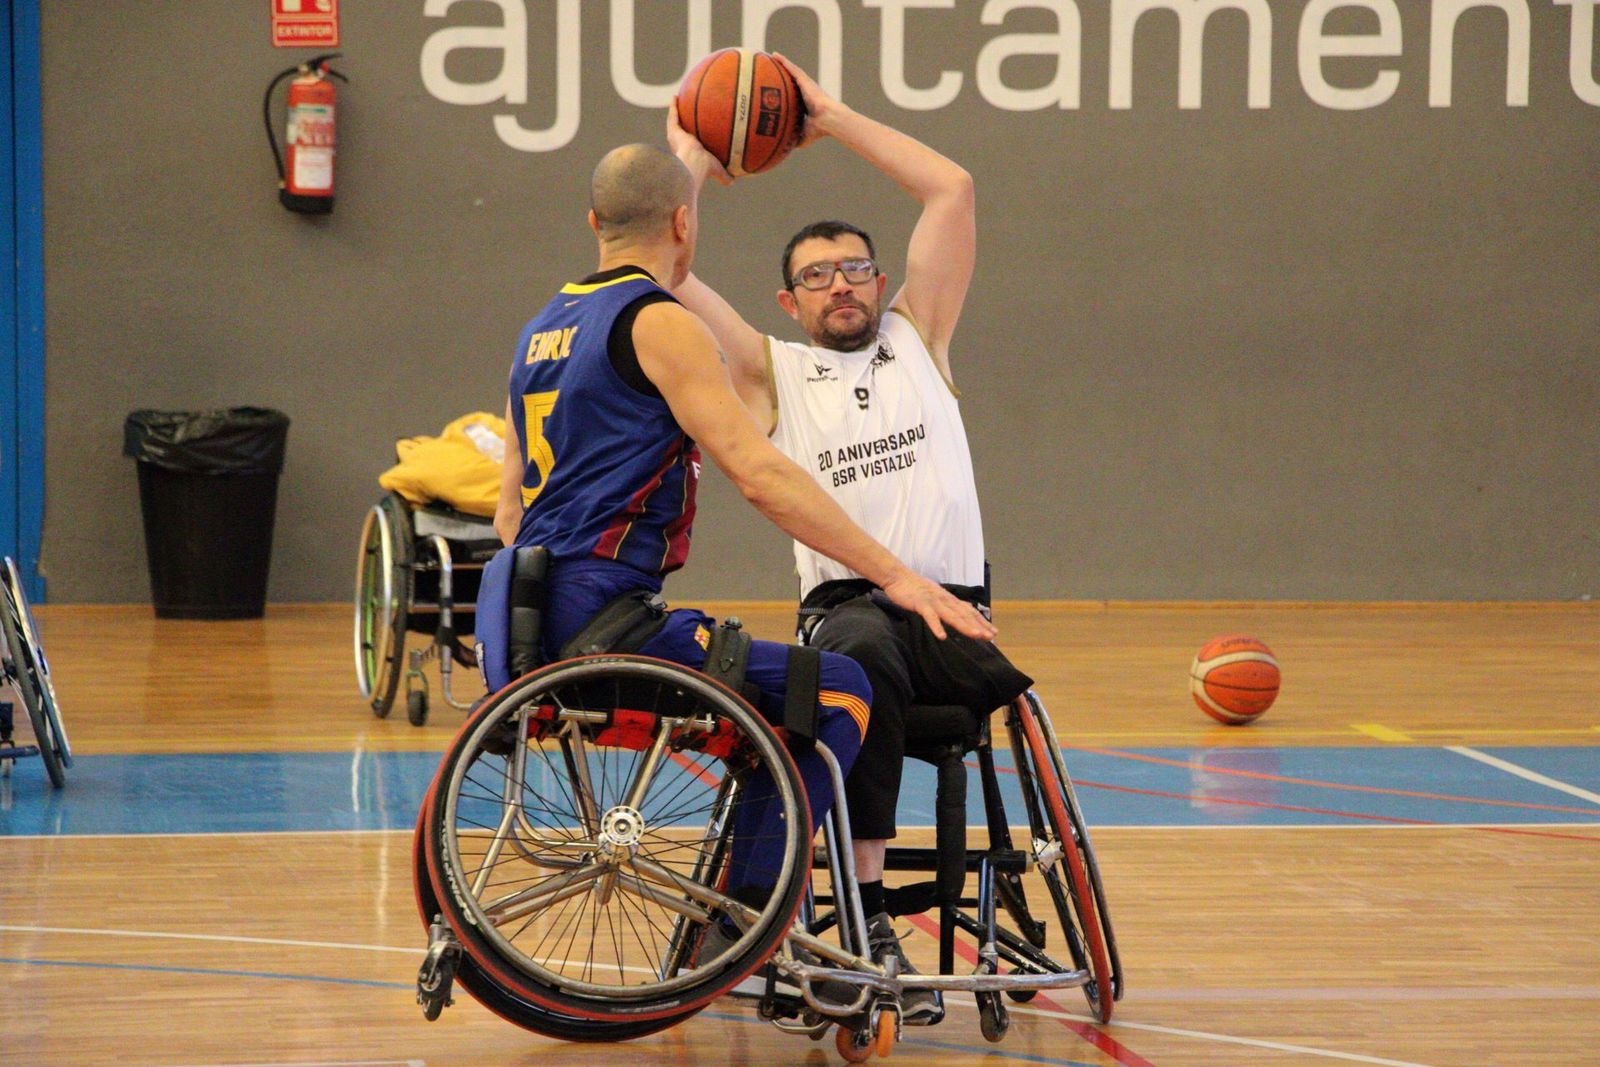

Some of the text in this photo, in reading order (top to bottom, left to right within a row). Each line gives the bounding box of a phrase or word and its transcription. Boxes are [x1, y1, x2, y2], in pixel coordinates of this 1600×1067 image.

[277, 25, 333, 37] EXTINTOR
[420, 0, 1600, 152] ajuntament
[854, 387, 870, 410] 9
[520, 388, 561, 509] 5
[818, 450, 833, 472] 20
[832, 450, 917, 488] BSR VISTAZUL
